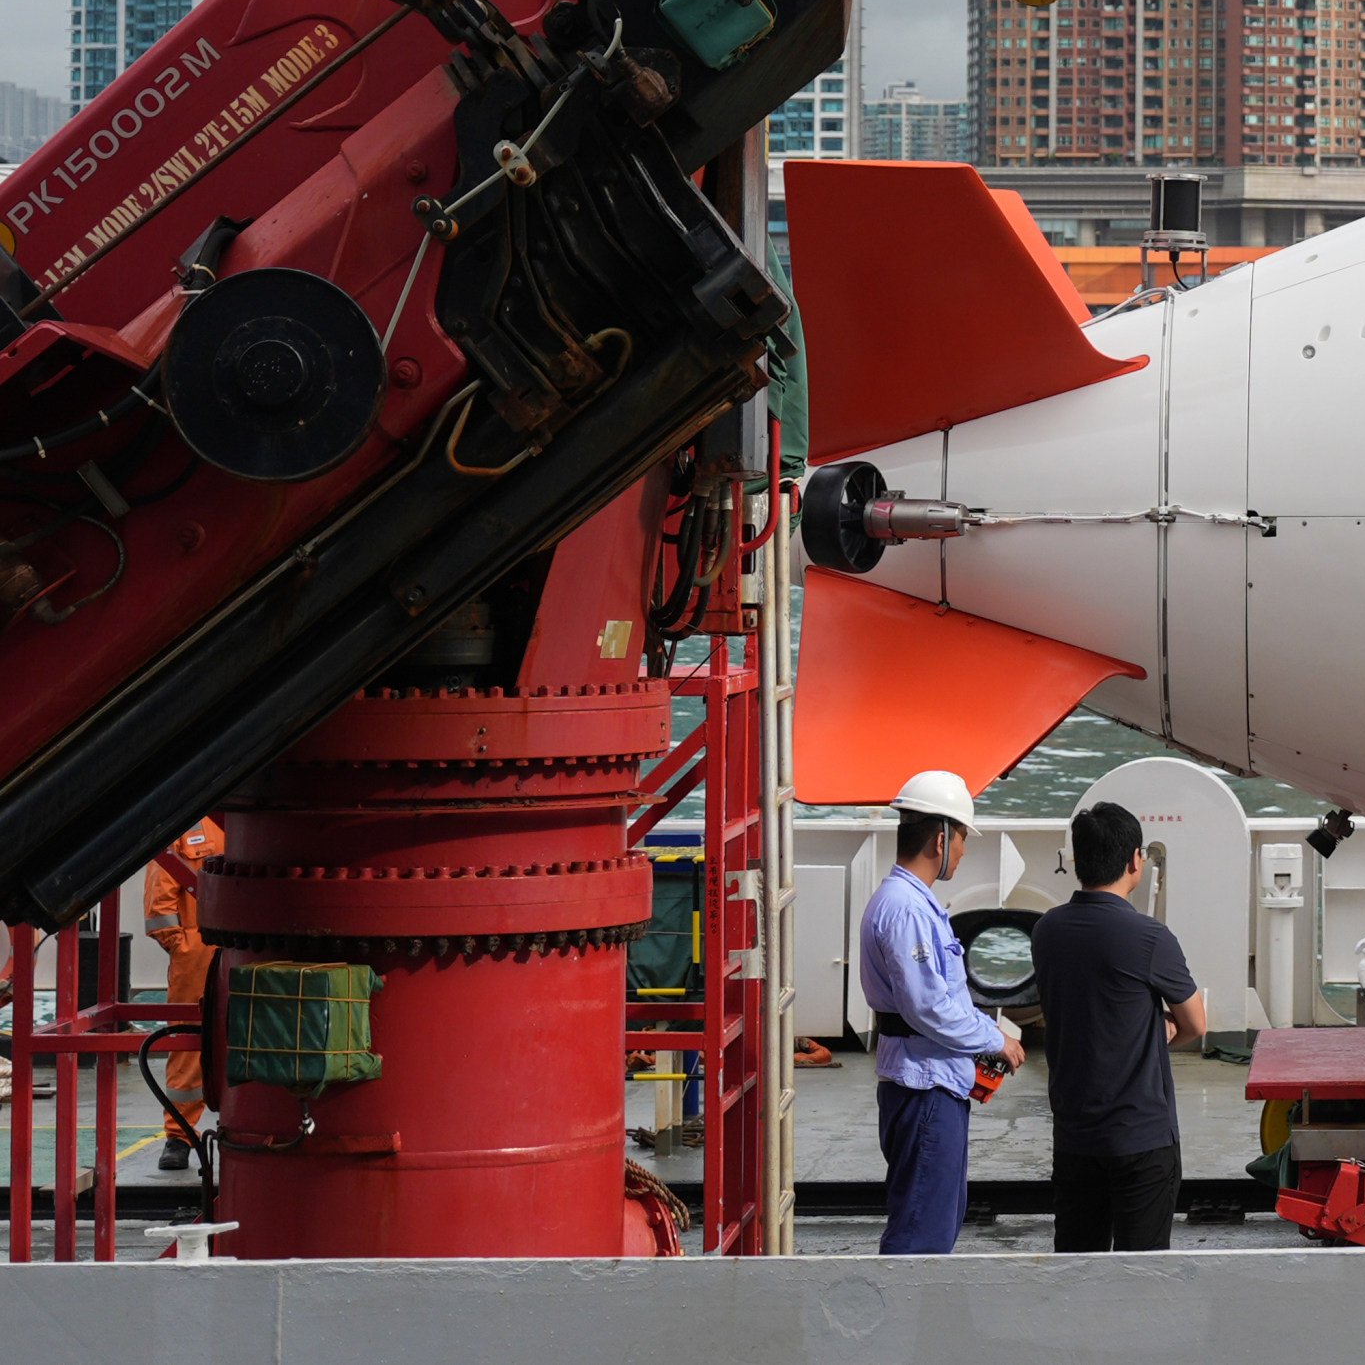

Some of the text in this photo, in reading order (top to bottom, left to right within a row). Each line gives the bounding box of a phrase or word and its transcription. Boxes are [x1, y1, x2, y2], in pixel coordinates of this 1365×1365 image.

[84, 194, 148, 252] MODE
[138, 145, 204, 210] 2/SWL
[193, 85, 271, 157] 2T-15M
[260, 35, 327, 98] MODE
[314, 23, 340, 50] 3
